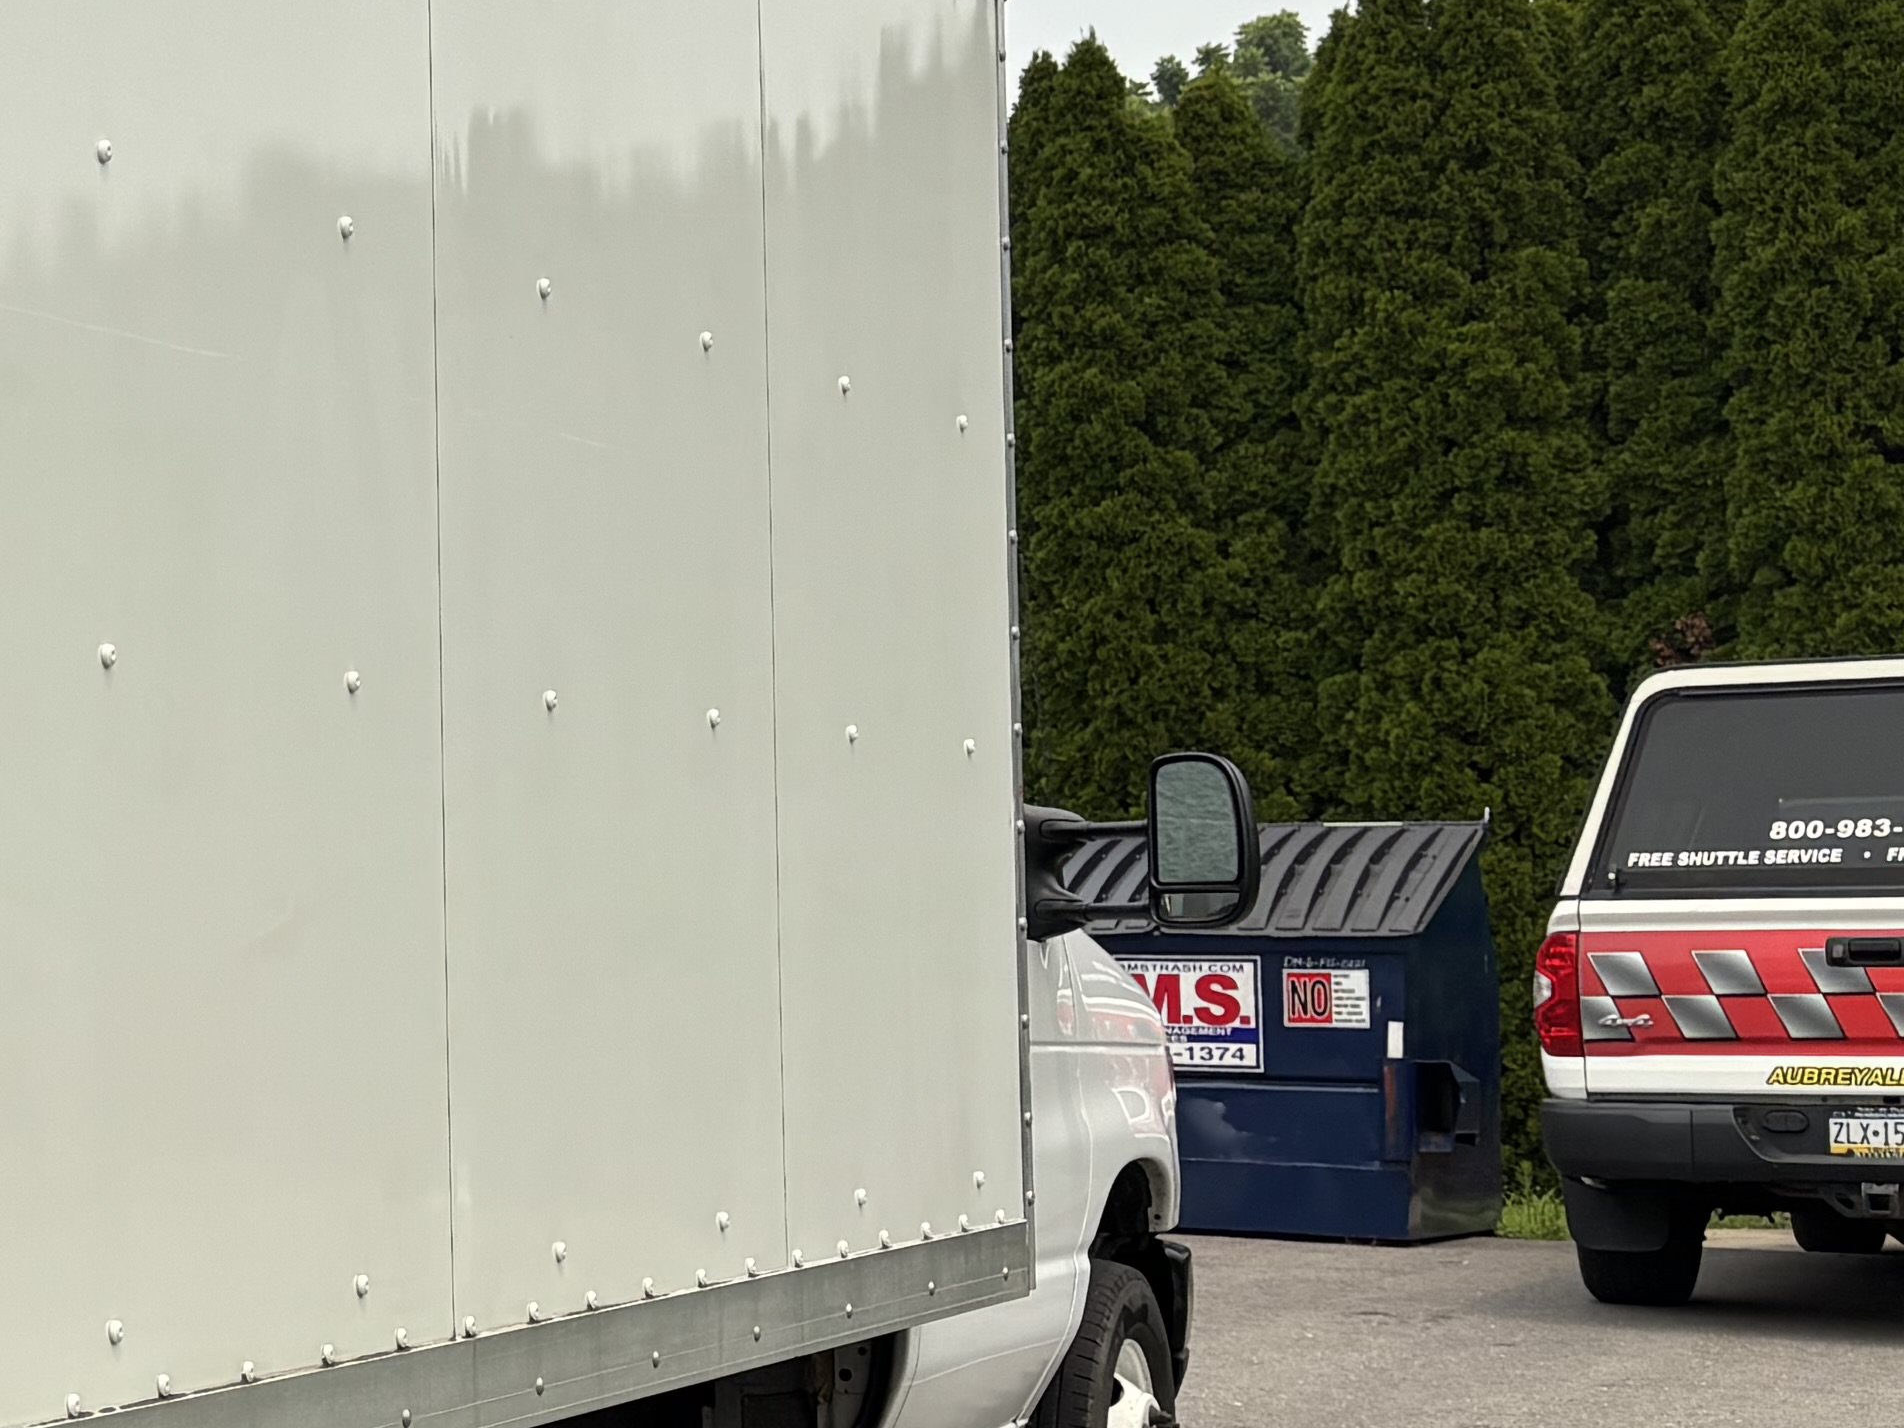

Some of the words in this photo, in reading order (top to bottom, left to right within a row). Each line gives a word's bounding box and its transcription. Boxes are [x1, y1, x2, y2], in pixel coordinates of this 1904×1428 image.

[1769, 818, 1904, 840] 800-983-
[1627, 852, 1674, 867] FREE
[1677, 850, 1761, 866] SHUTTLE
[1764, 848, 1843, 864] SERVICE
[1290, 978, 1328, 1017] NO
